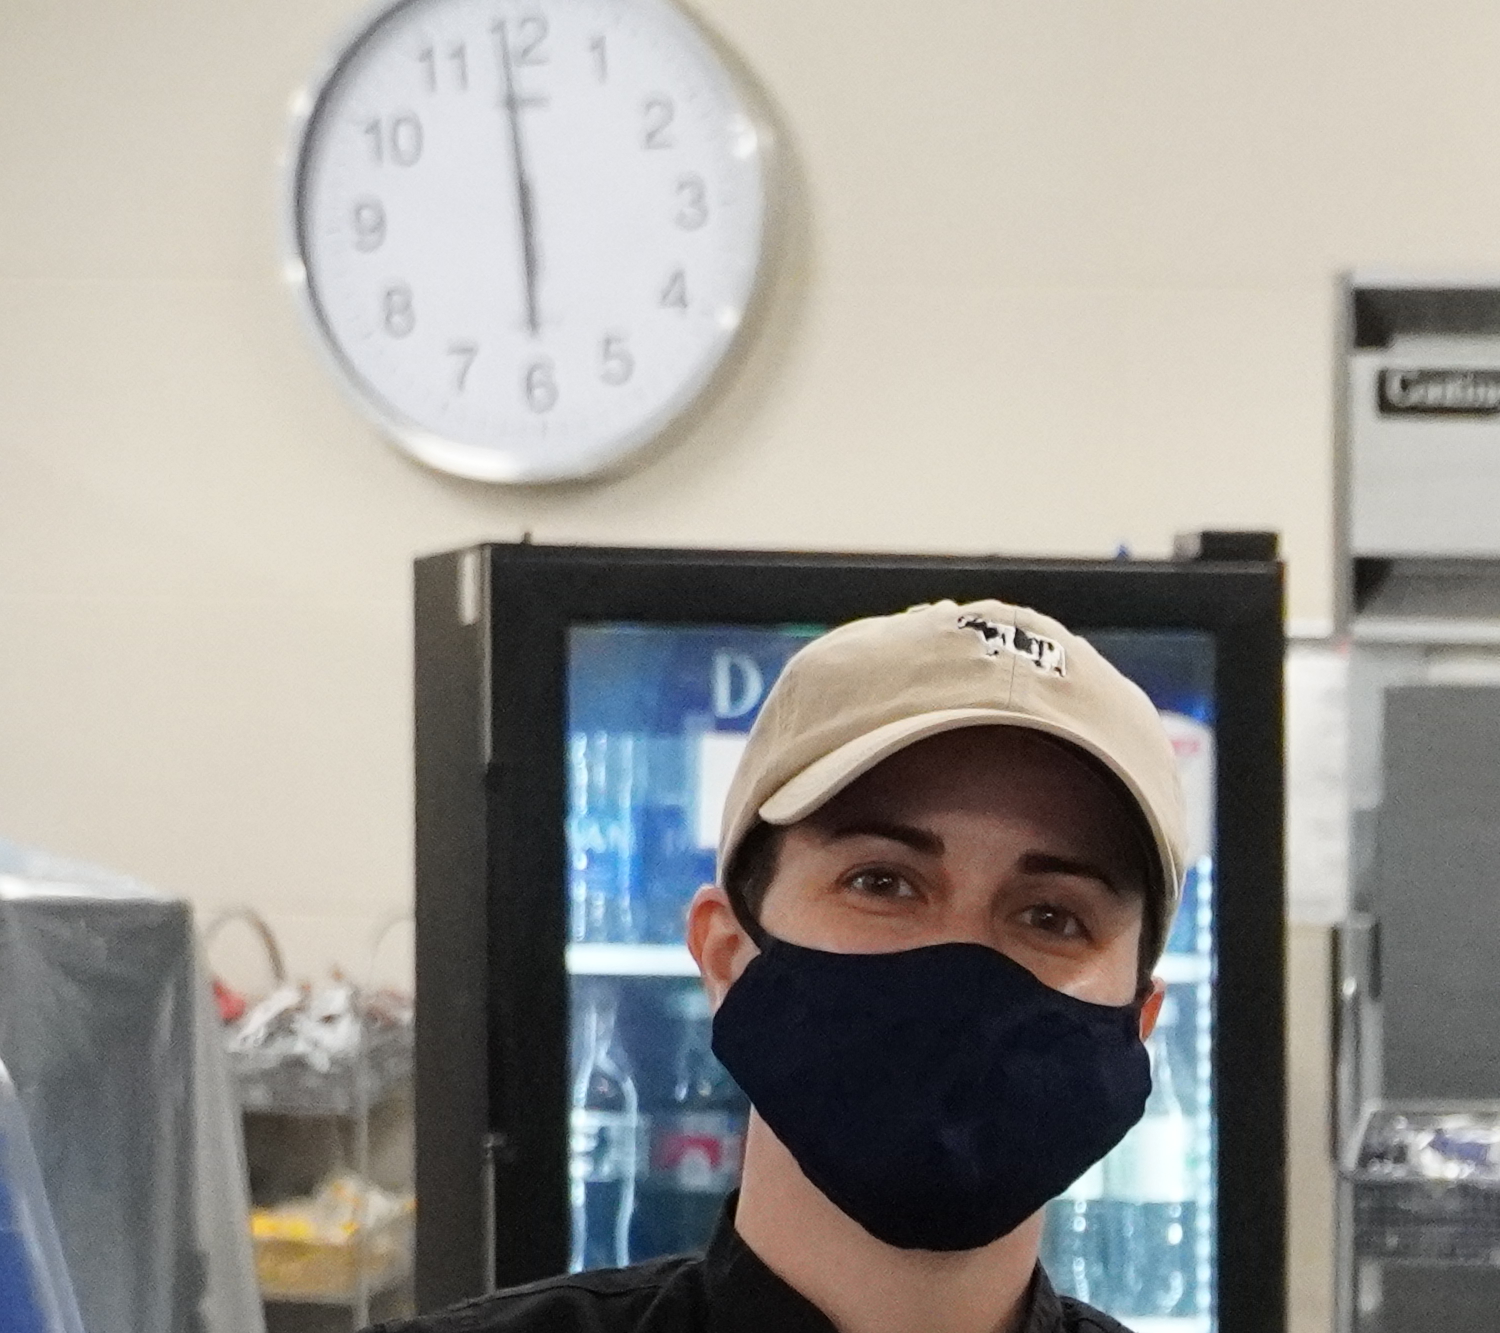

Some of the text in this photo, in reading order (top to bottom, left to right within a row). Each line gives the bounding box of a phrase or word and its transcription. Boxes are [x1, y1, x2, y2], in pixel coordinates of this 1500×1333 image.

[419, 43, 469, 91] 11
[589, 36, 608, 84] 1
[364, 111, 424, 167] 10
[641, 96, 674, 150] 2
[353, 200, 387, 253] 9
[675, 177, 708, 231] 3
[383, 282, 416, 338] 8
[659, 267, 689, 313] 4
[448, 342, 479, 392] 7
[525, 357, 559, 413] 6
[599, 335, 635, 386] 5
